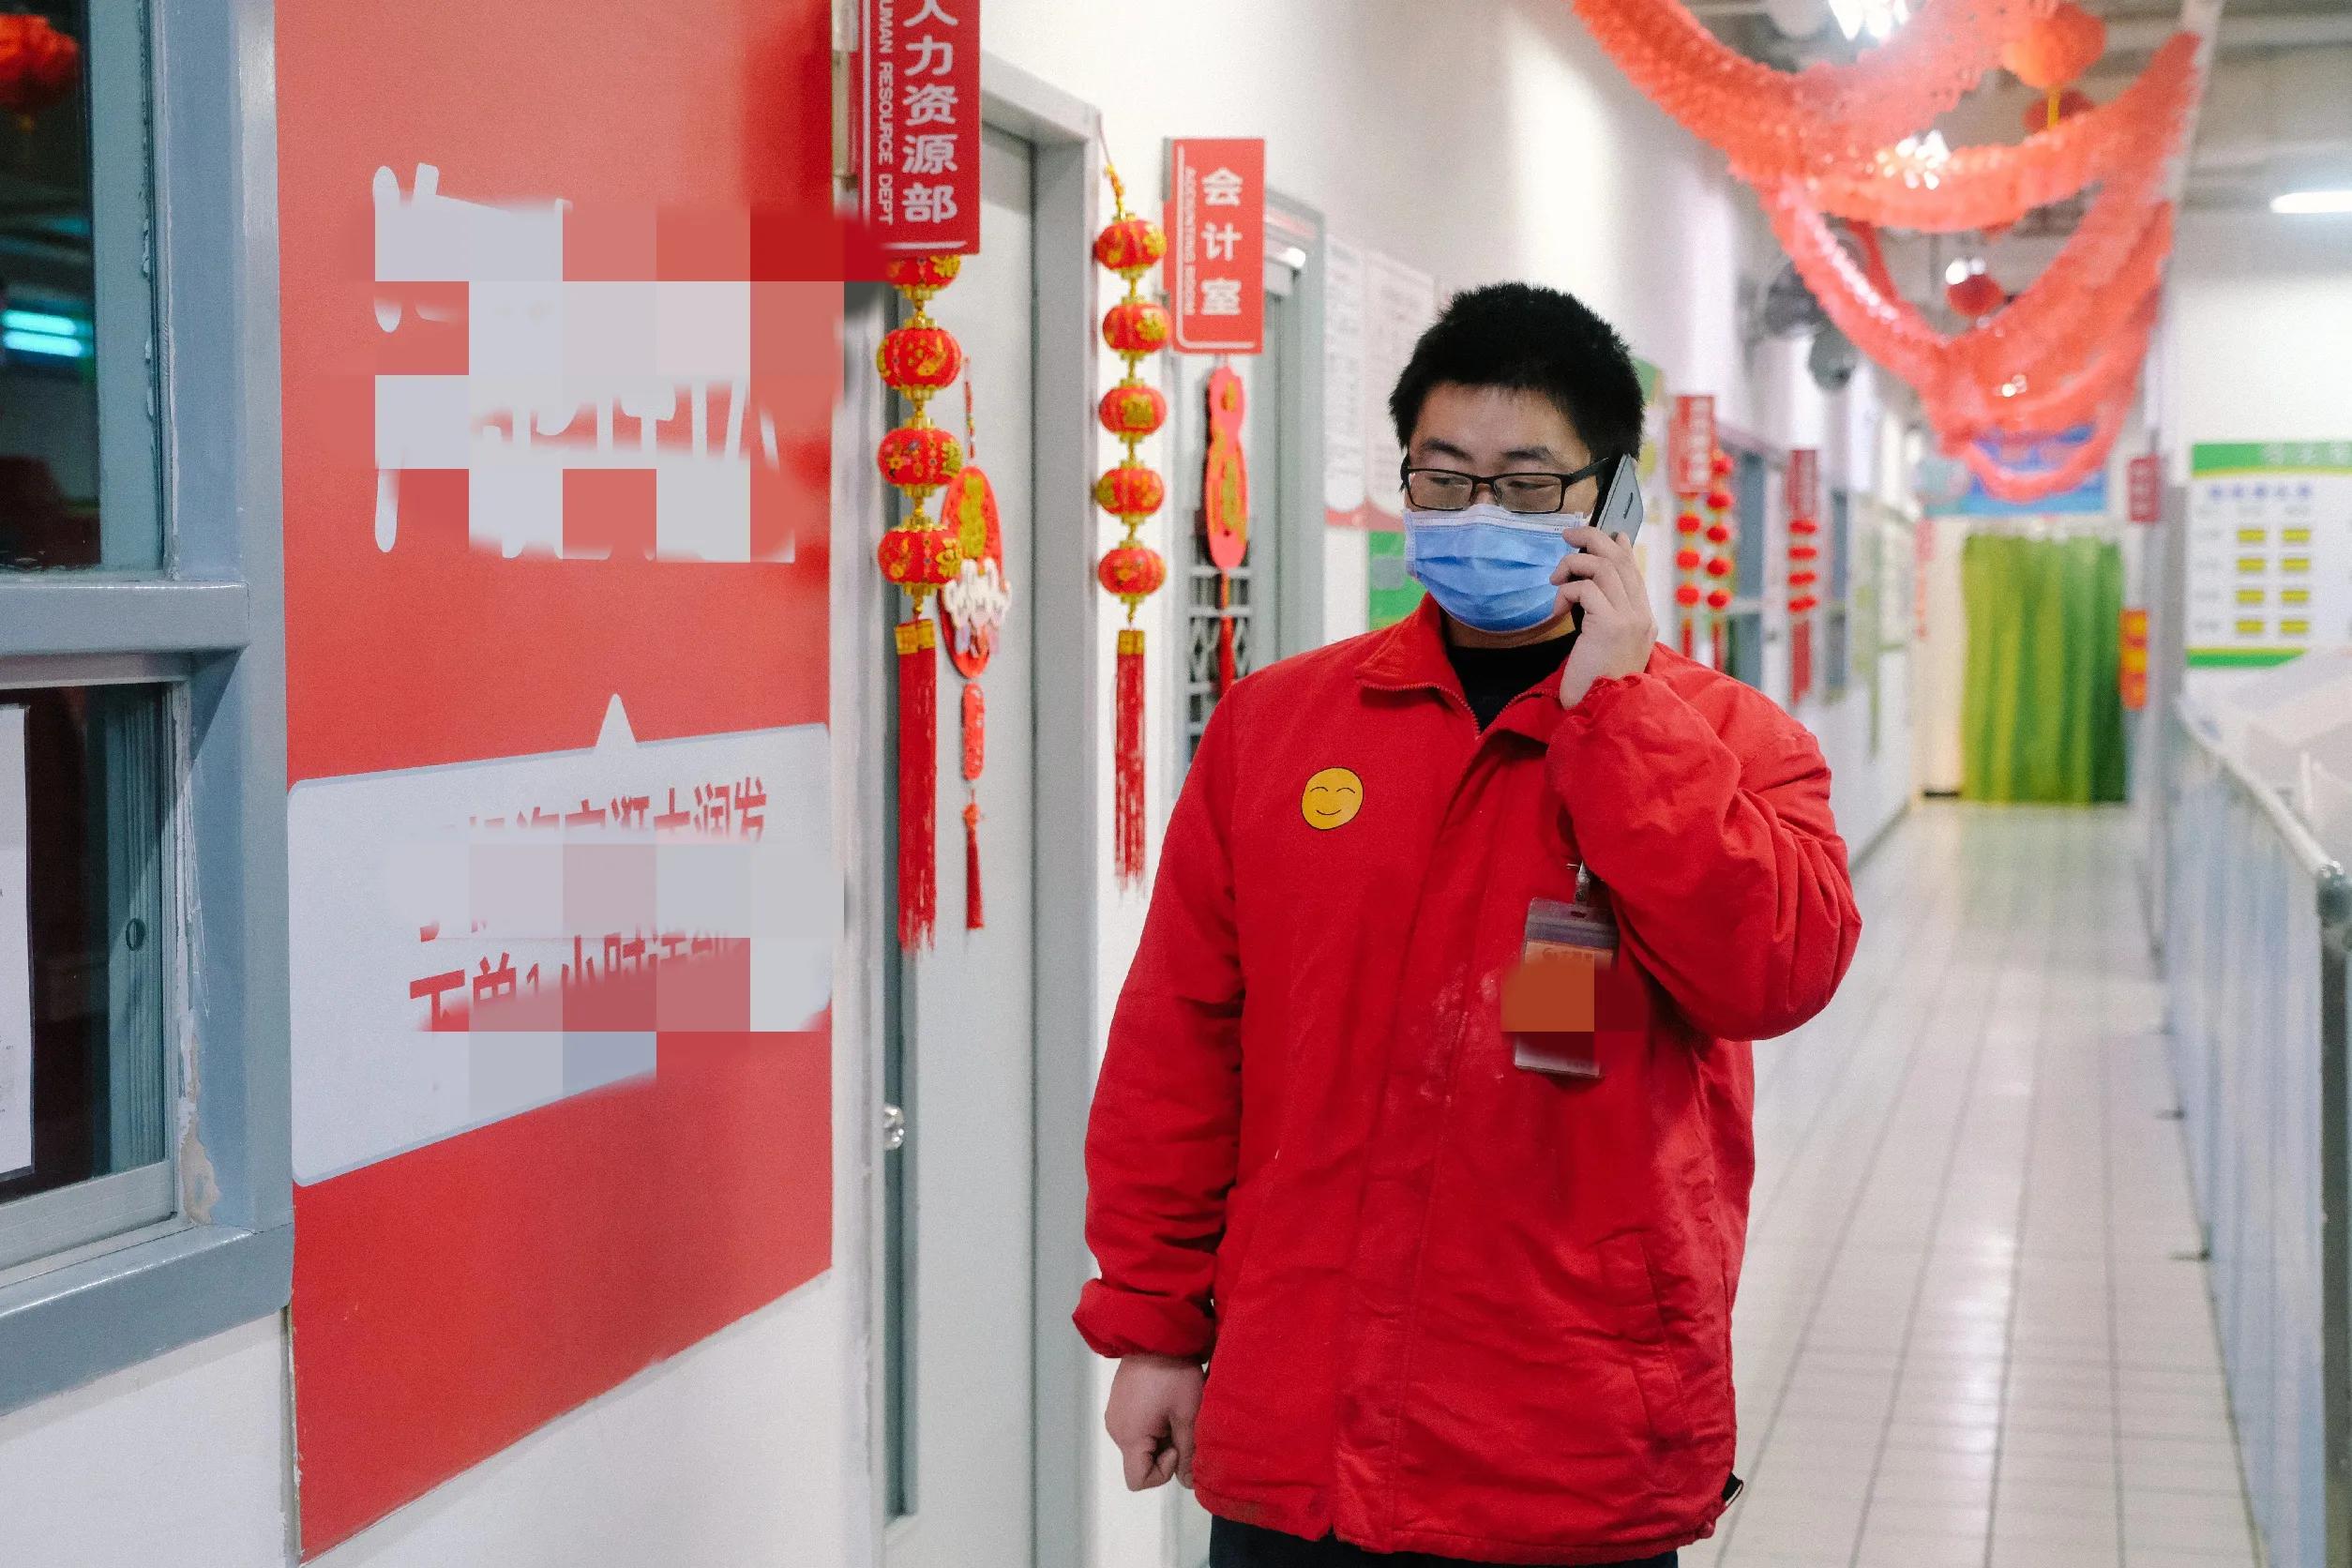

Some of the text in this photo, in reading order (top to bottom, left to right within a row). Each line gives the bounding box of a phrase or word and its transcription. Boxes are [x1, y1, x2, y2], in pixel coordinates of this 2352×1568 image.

[878, 61, 894, 166] RESOURCE
[902, 0, 959, 224] 人力资源部
[878, 173, 894, 226] DEPT
[1200, 166, 1244, 316] 会计室
